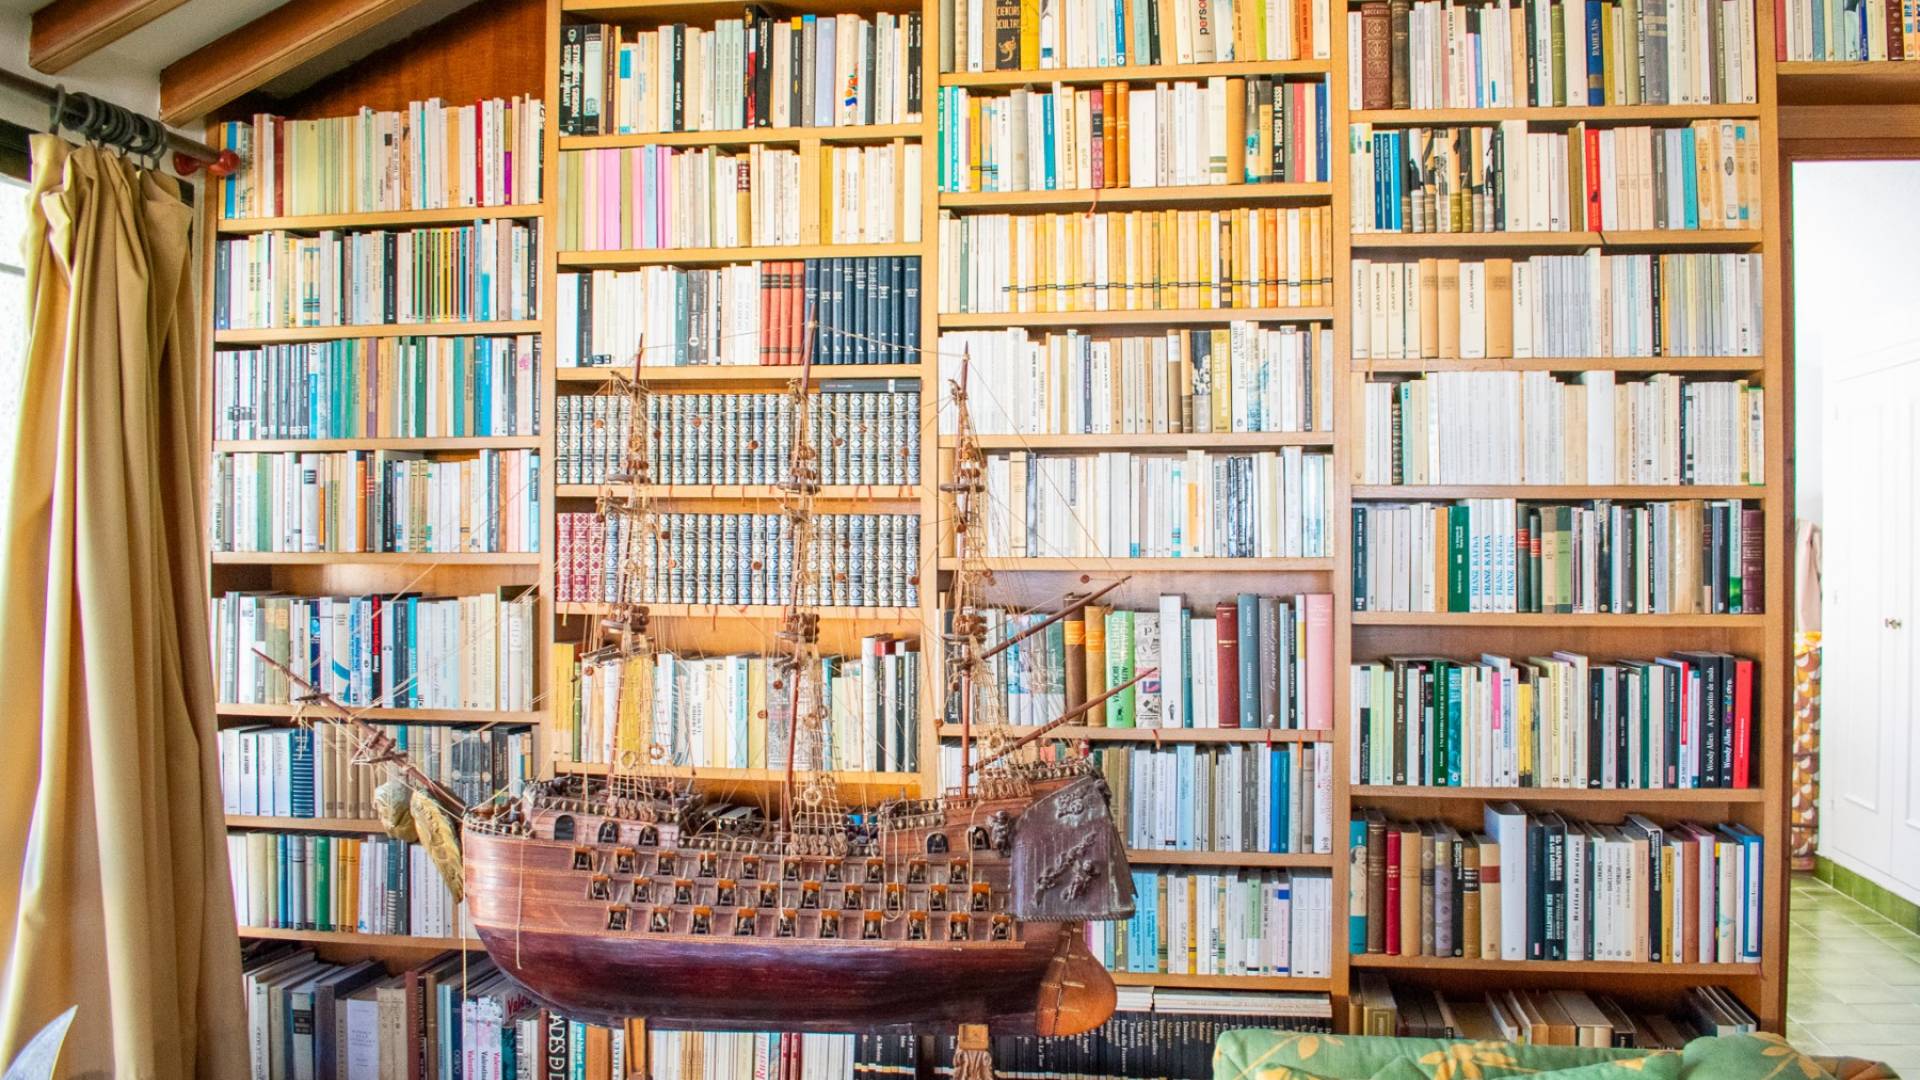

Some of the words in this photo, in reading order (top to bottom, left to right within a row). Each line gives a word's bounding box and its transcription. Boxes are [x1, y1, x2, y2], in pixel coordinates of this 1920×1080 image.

[1591, 18, 1600, 56] RABELAIS
[1274, 86, 1283, 110] PICASSO
[1274, 119, 1283, 146] PROCESO
[1723, 728, 1732, 746] Allen.
[1723, 747, 1732, 768] Woody
